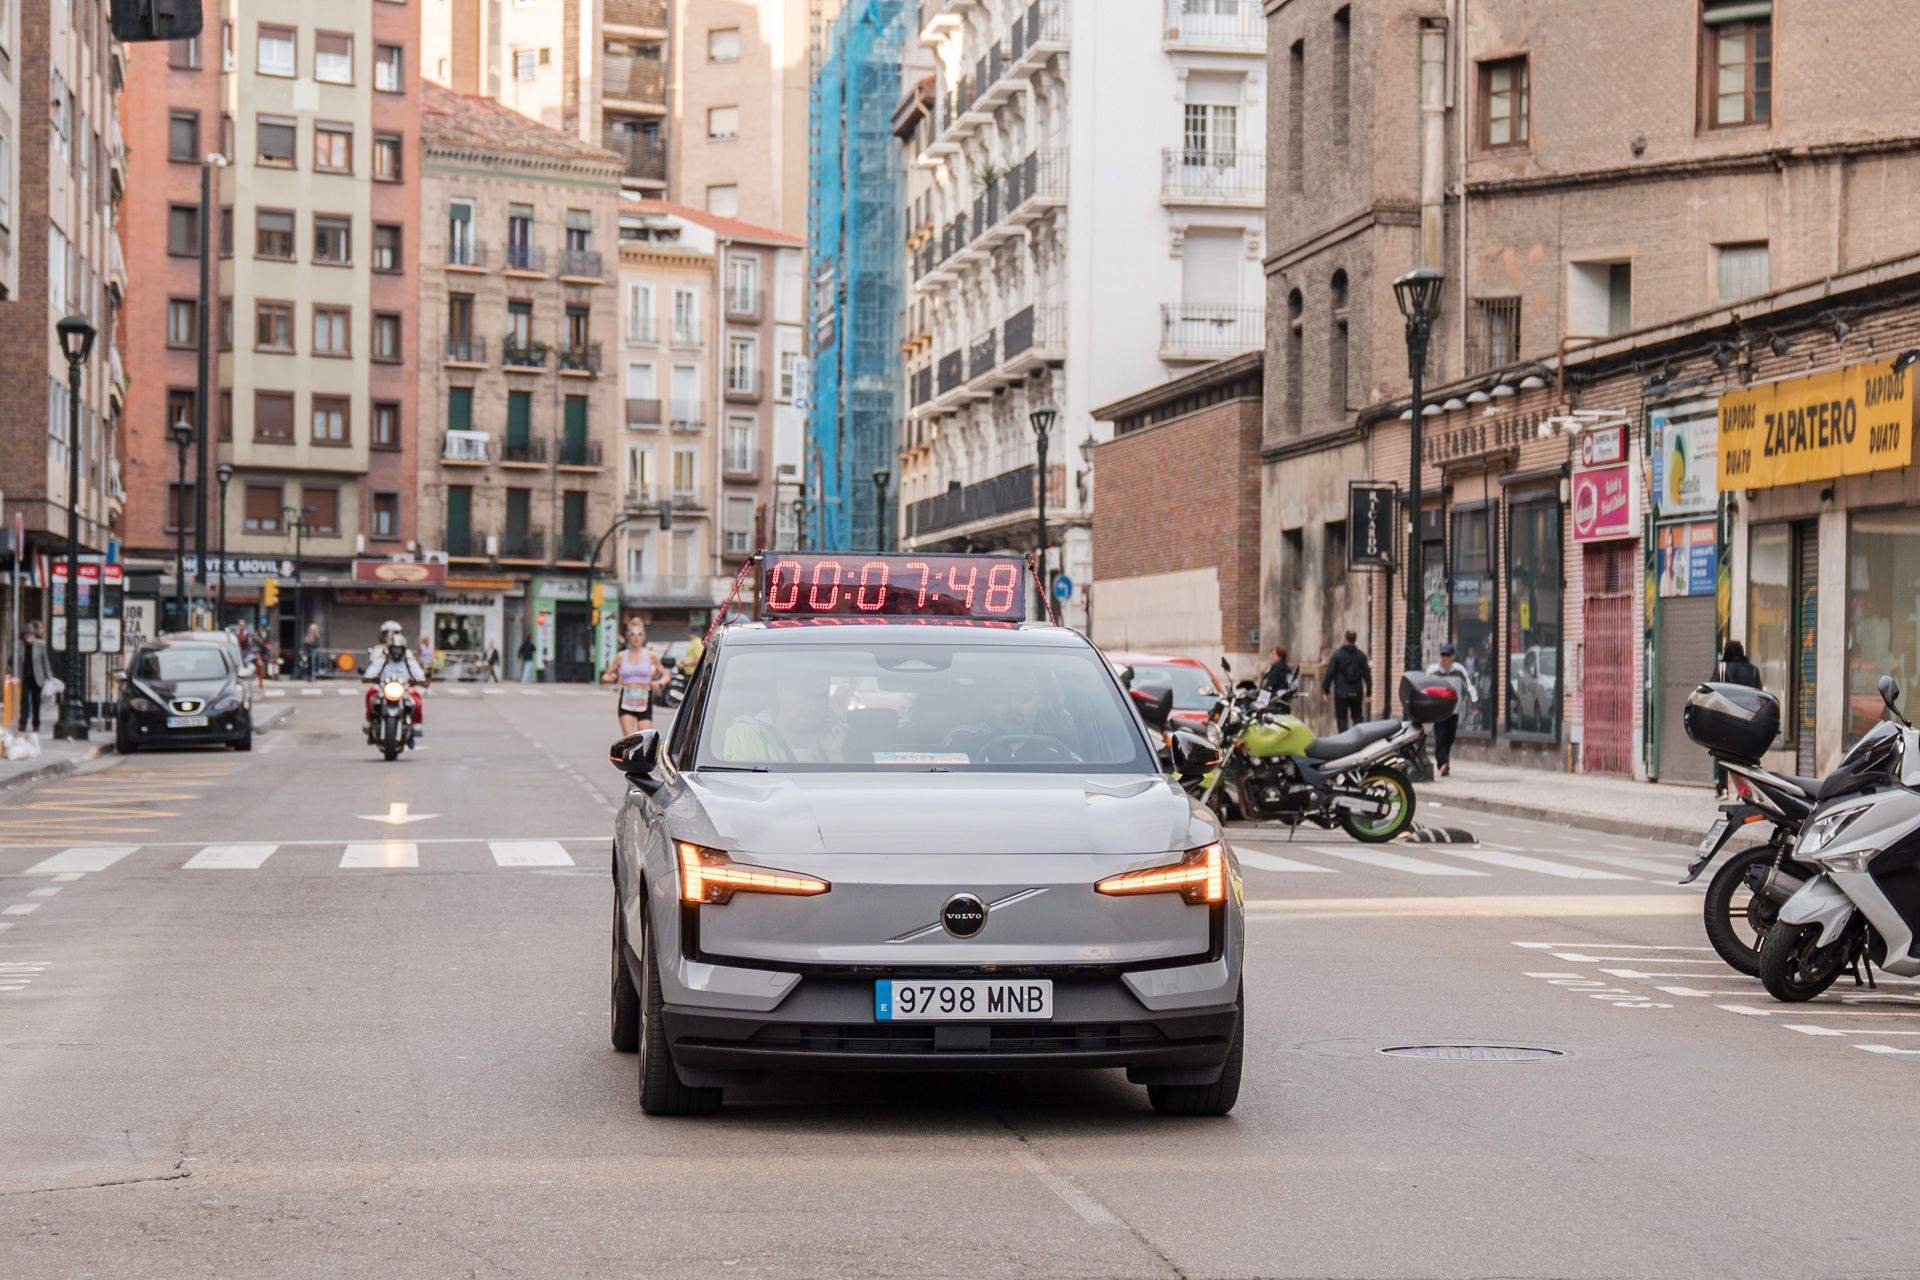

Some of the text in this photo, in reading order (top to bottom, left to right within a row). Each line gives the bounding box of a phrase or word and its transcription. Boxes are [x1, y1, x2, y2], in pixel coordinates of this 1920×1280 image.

[1864, 373, 1905, 408] RAPIDOS
[1722, 403, 1756, 435] RAPIDOS
[1764, 398, 1857, 457] ZAPATERO
[1869, 422, 1900, 455] DUATO
[1726, 449, 1752, 477] DUATO
[1367, 491, 1379, 556] RICARDO
[768, 560, 1017, 613] 00:07:48
[880, 1003, 887, 1011] E
[899, 986, 1044, 1013] 9798 MNB
